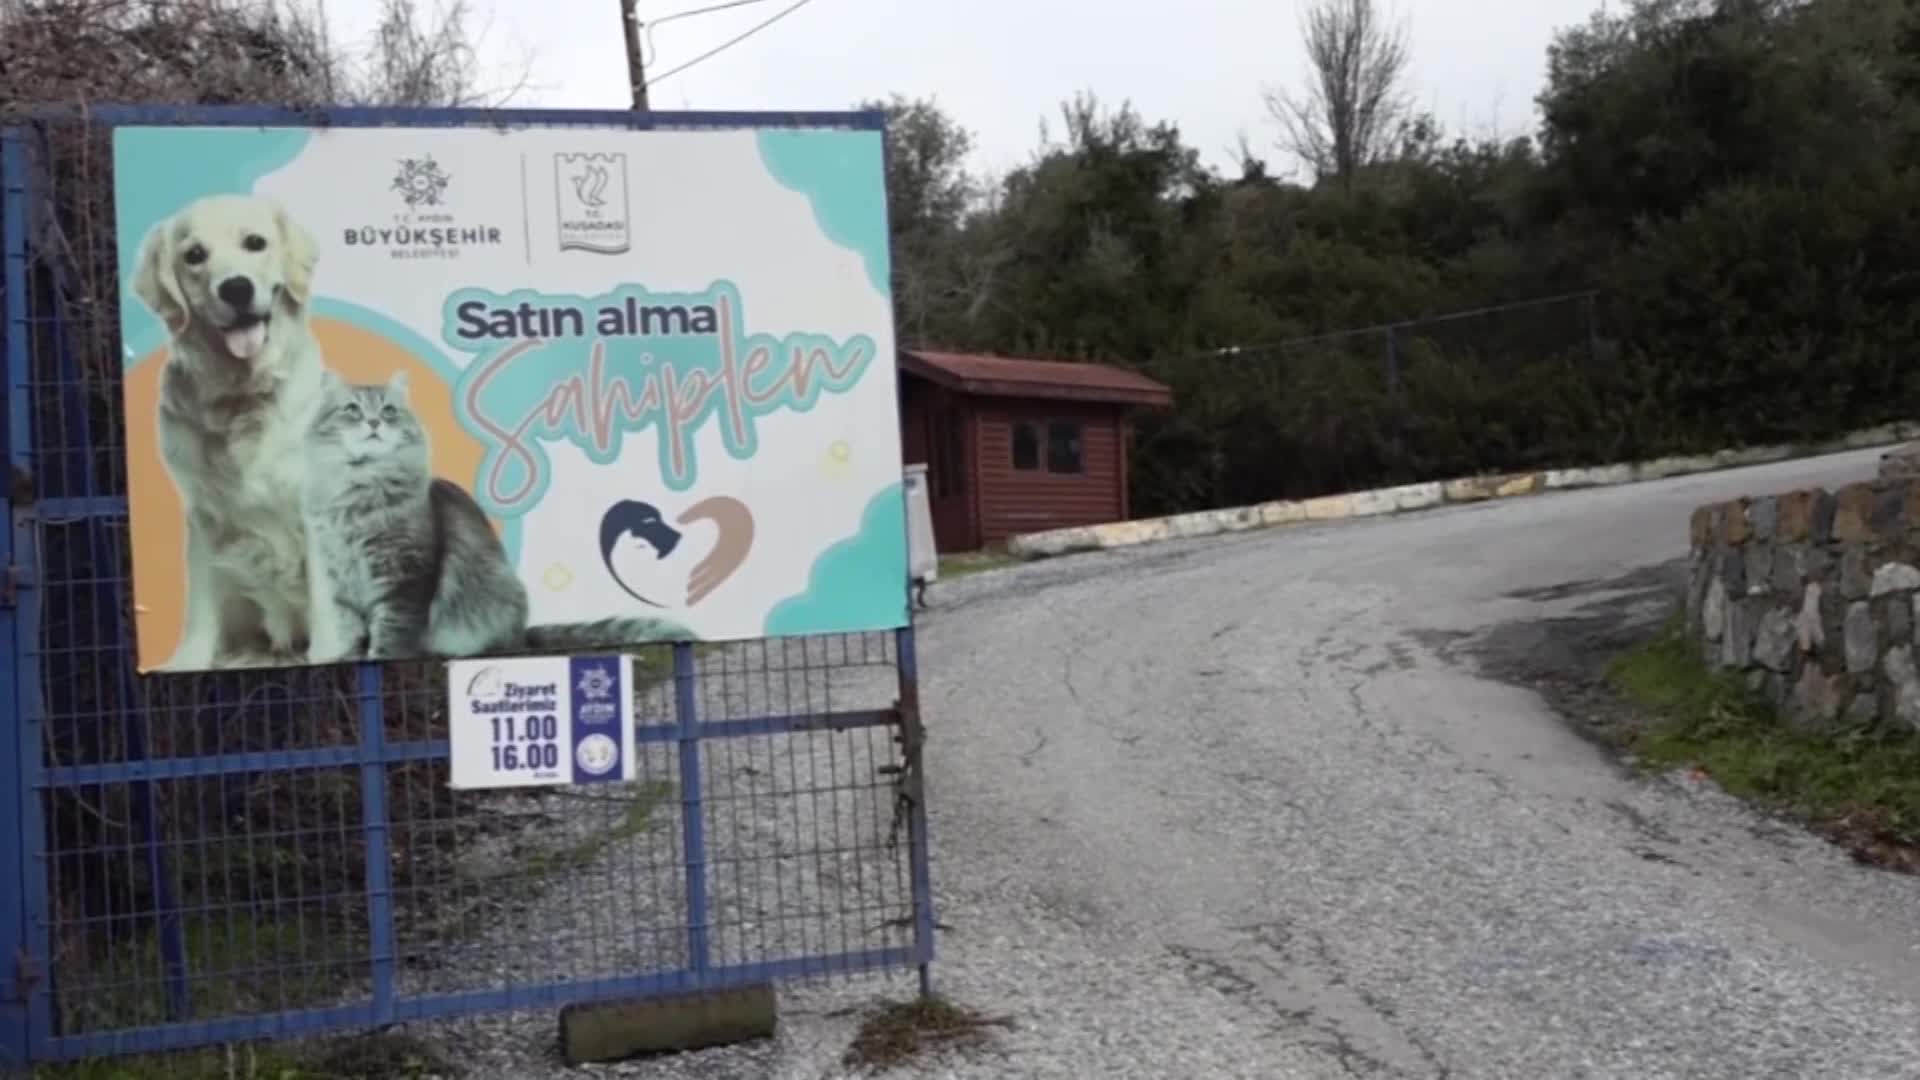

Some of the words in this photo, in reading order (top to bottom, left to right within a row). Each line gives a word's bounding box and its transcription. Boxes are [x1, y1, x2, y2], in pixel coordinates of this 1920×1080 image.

[343, 224, 502, 248] BÜYÜKŞEHİR
[457, 301, 583, 338] Satın
[597, 298, 717, 336] alma
[466, 294, 864, 504] Sahiplen
[504, 682, 557, 699] Ziyaret
[491, 715, 558, 742] 11.00
[492, 743, 559, 771] 16.00
